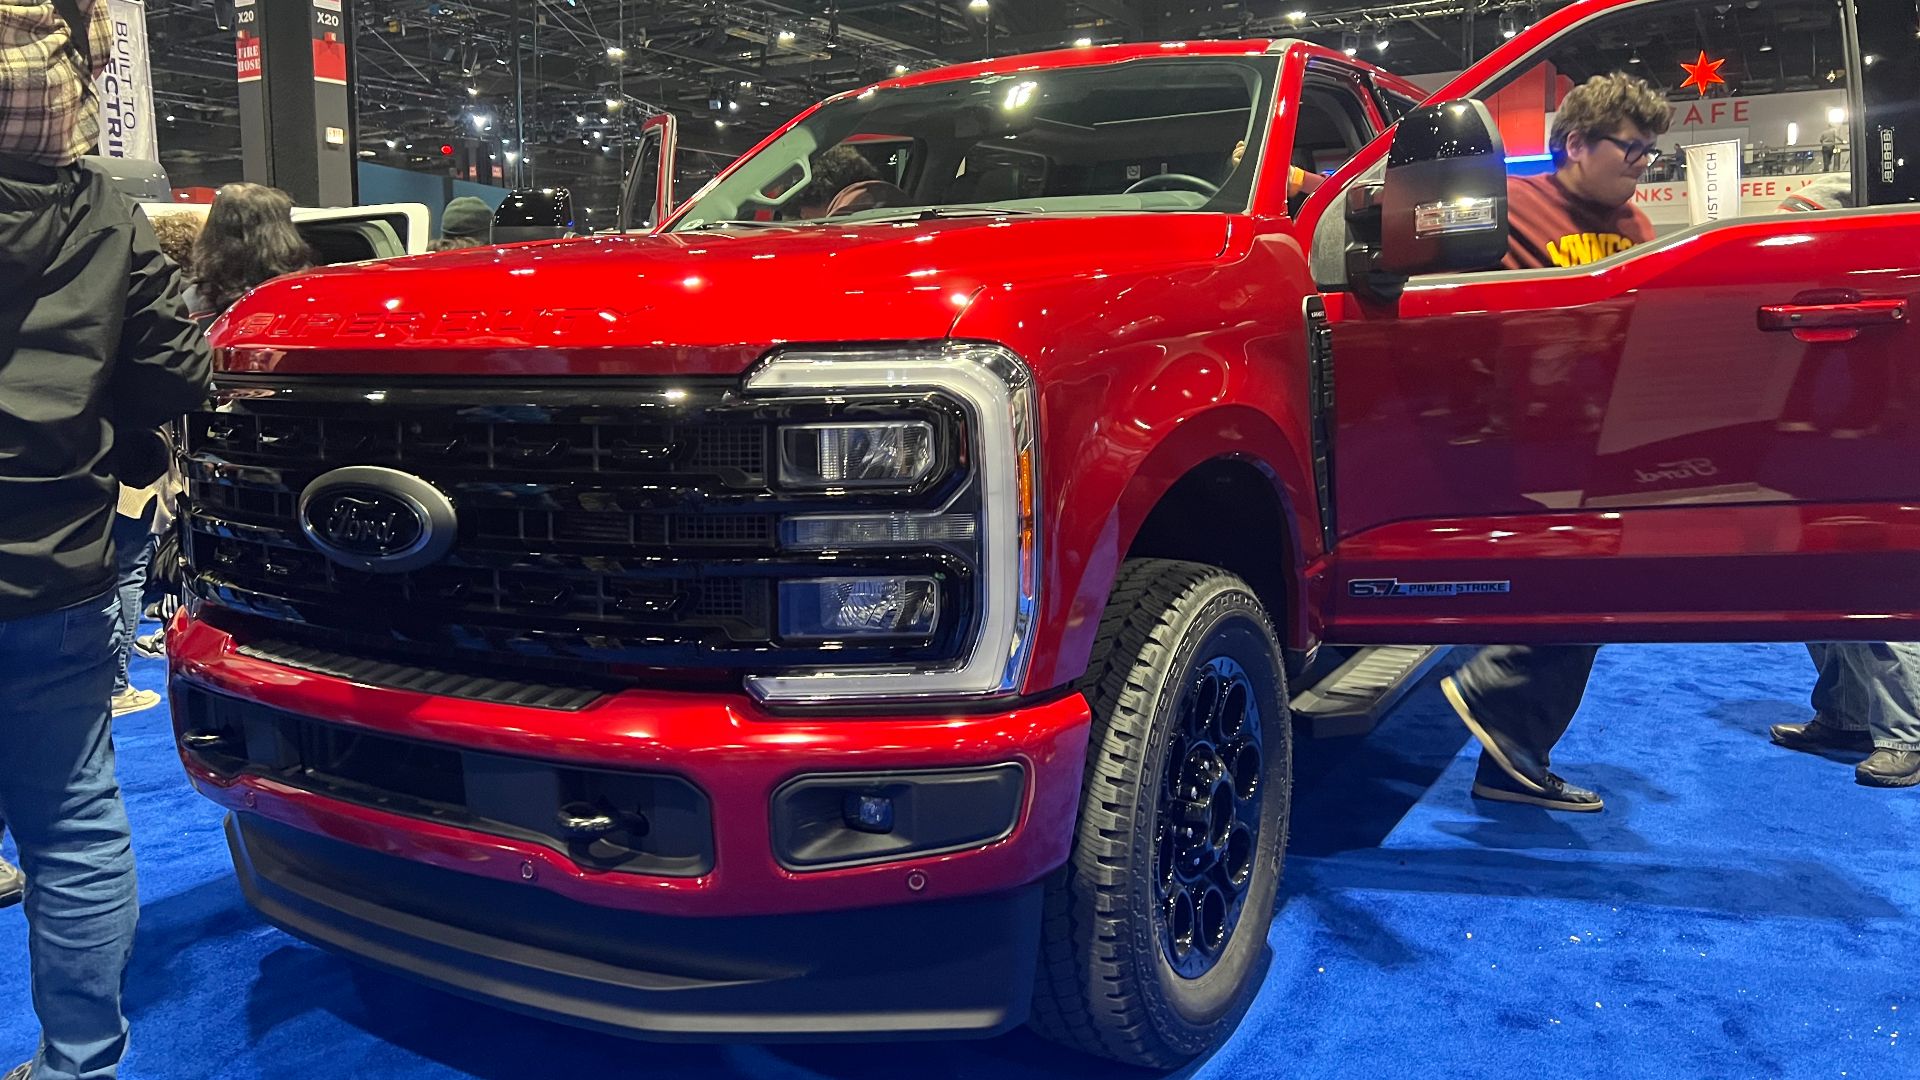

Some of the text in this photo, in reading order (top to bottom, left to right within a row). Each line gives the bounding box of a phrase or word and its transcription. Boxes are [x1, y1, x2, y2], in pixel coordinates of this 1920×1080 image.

[238, 10, 255, 23] X20
[317, 11, 340, 26] X20
[238, 45, 259, 59] FIRE
[116, 21, 136, 130] BUILT TO
[237, 58, 261, 72] HOSE
[104, 56, 124, 158] ECTRI
[1706, 152, 1718, 192] DITCH
[230, 304, 656, 339] SUPER DUTY
[328, 496, 398, 544] Ford
[1408, 583, 1453, 594] POWER
[1455, 582, 1505, 593] STROKE
